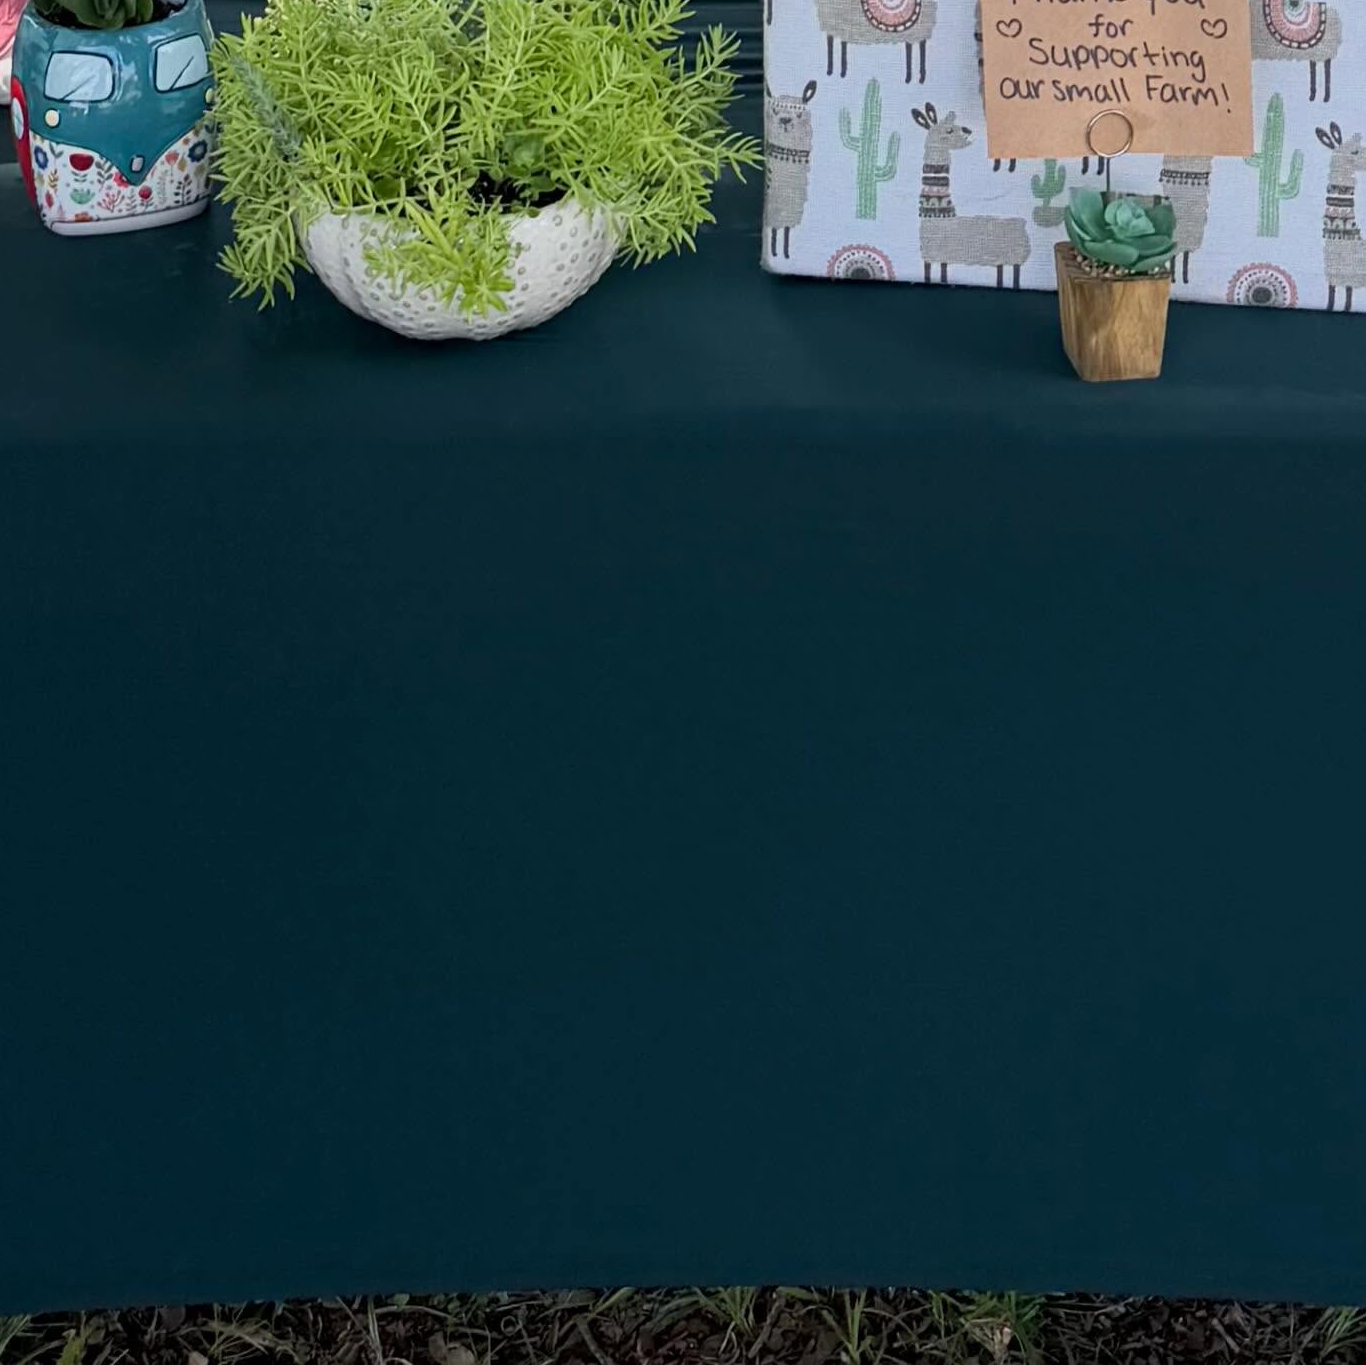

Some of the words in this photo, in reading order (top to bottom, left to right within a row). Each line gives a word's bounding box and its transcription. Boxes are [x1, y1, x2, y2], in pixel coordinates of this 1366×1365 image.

[1087, 13, 1134, 39] for
[1028, 37, 1206, 83] Supporting
[999, 77, 1046, 99] our
[1052, 77, 1131, 103] small
[1144, 74, 1232, 114] Farm!
